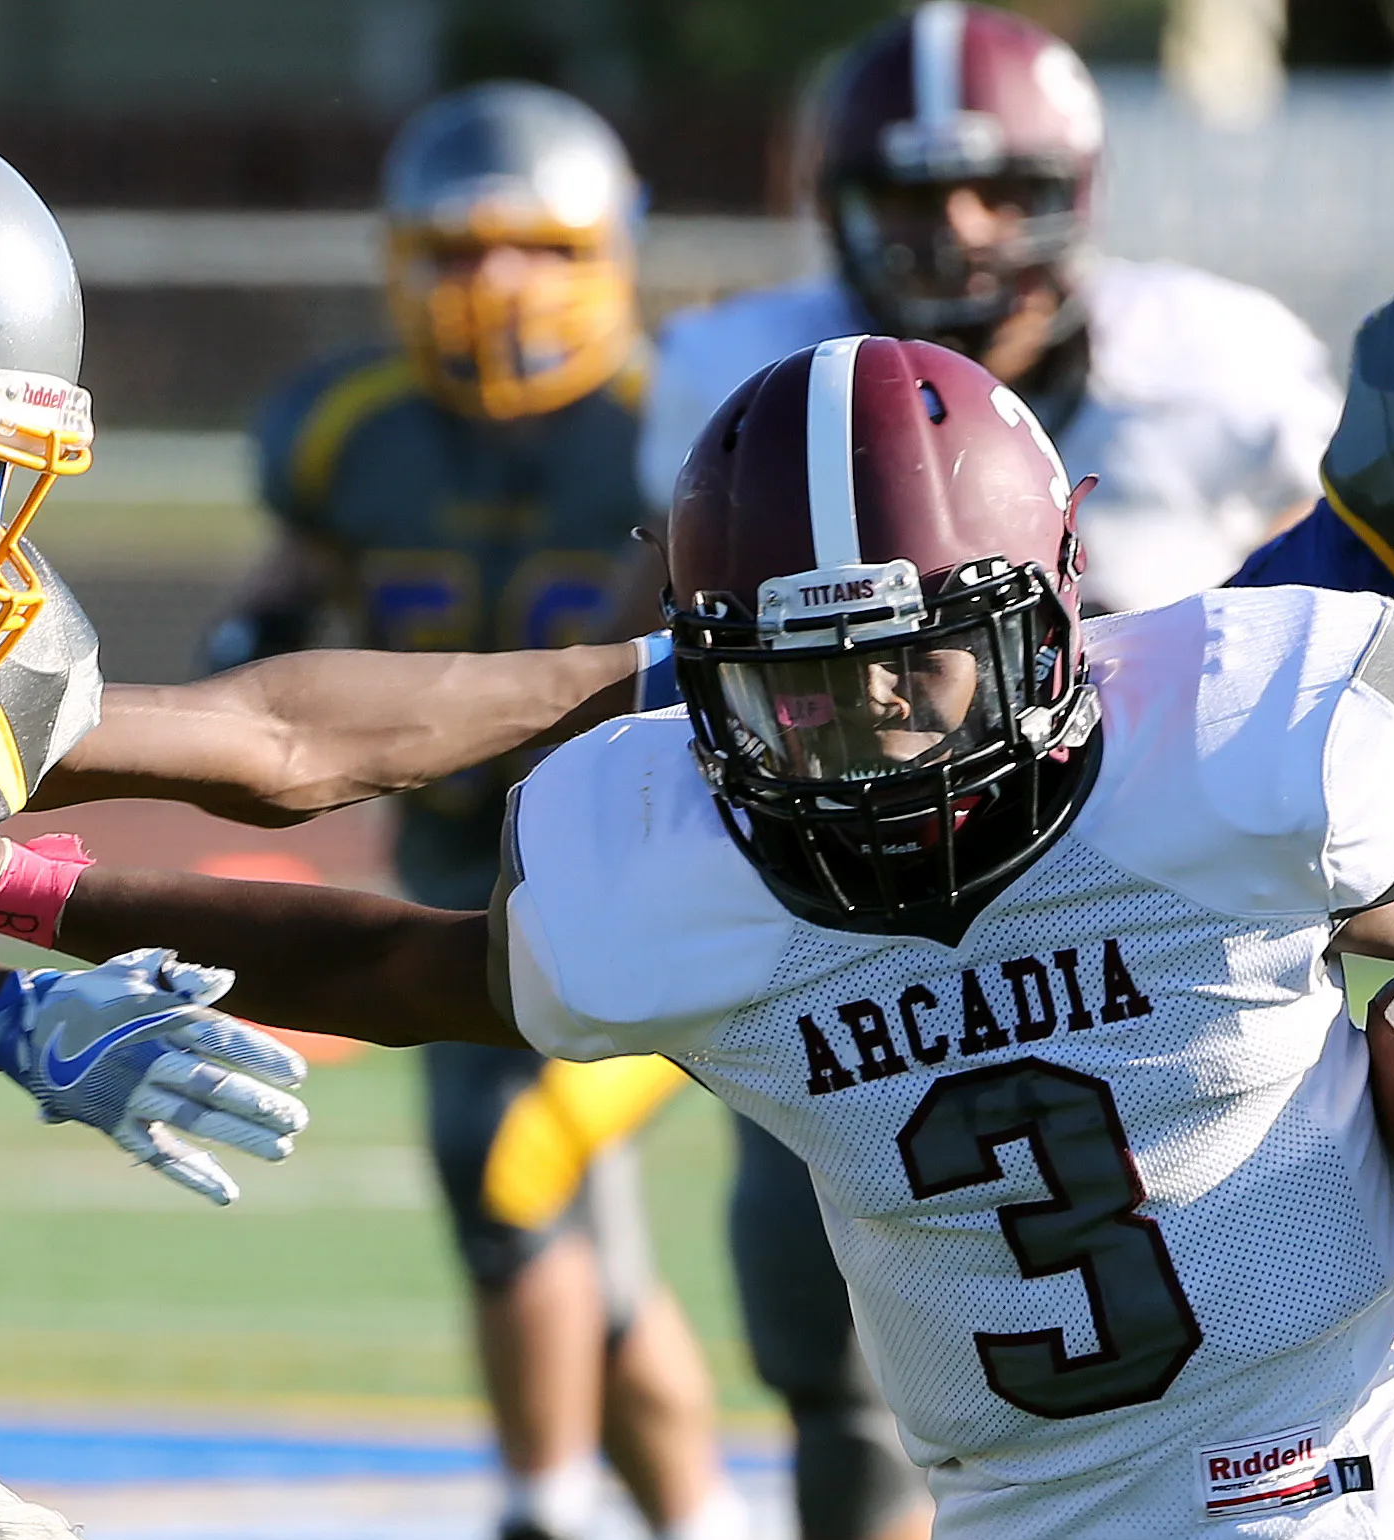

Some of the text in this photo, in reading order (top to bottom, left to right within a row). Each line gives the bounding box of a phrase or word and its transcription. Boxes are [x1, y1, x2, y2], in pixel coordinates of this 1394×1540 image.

[798, 578, 875, 608] TITANS
[796, 938, 1154, 1096] ARCADIA
[895, 1055, 1204, 1420] 3
[1208, 1437, 1317, 1481] Riddell
[1343, 1464, 1362, 1489] M
